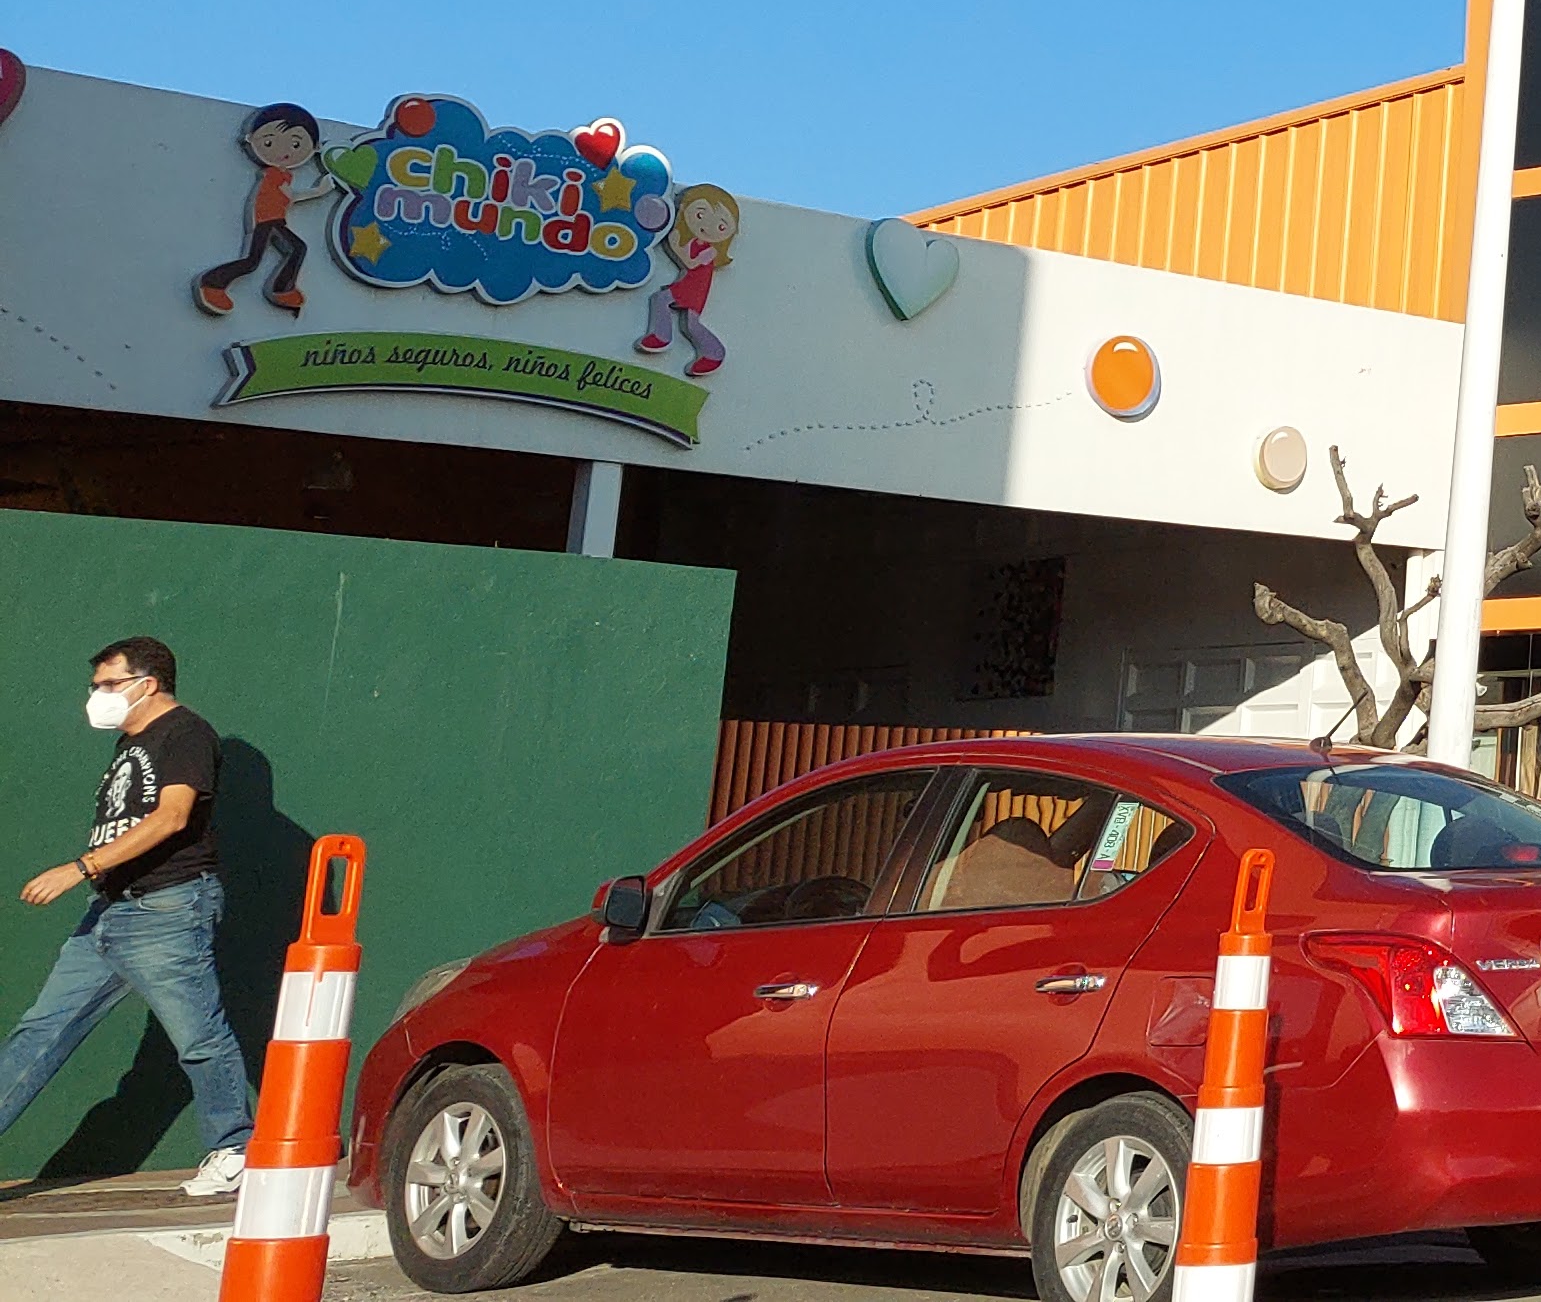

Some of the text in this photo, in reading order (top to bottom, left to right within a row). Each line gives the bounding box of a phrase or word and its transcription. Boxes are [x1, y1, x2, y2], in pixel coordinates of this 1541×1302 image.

[385, 144, 585, 217] chiki
[373, 182, 639, 261] mundo
[300, 342, 653, 401] niños seguros, niños felices
